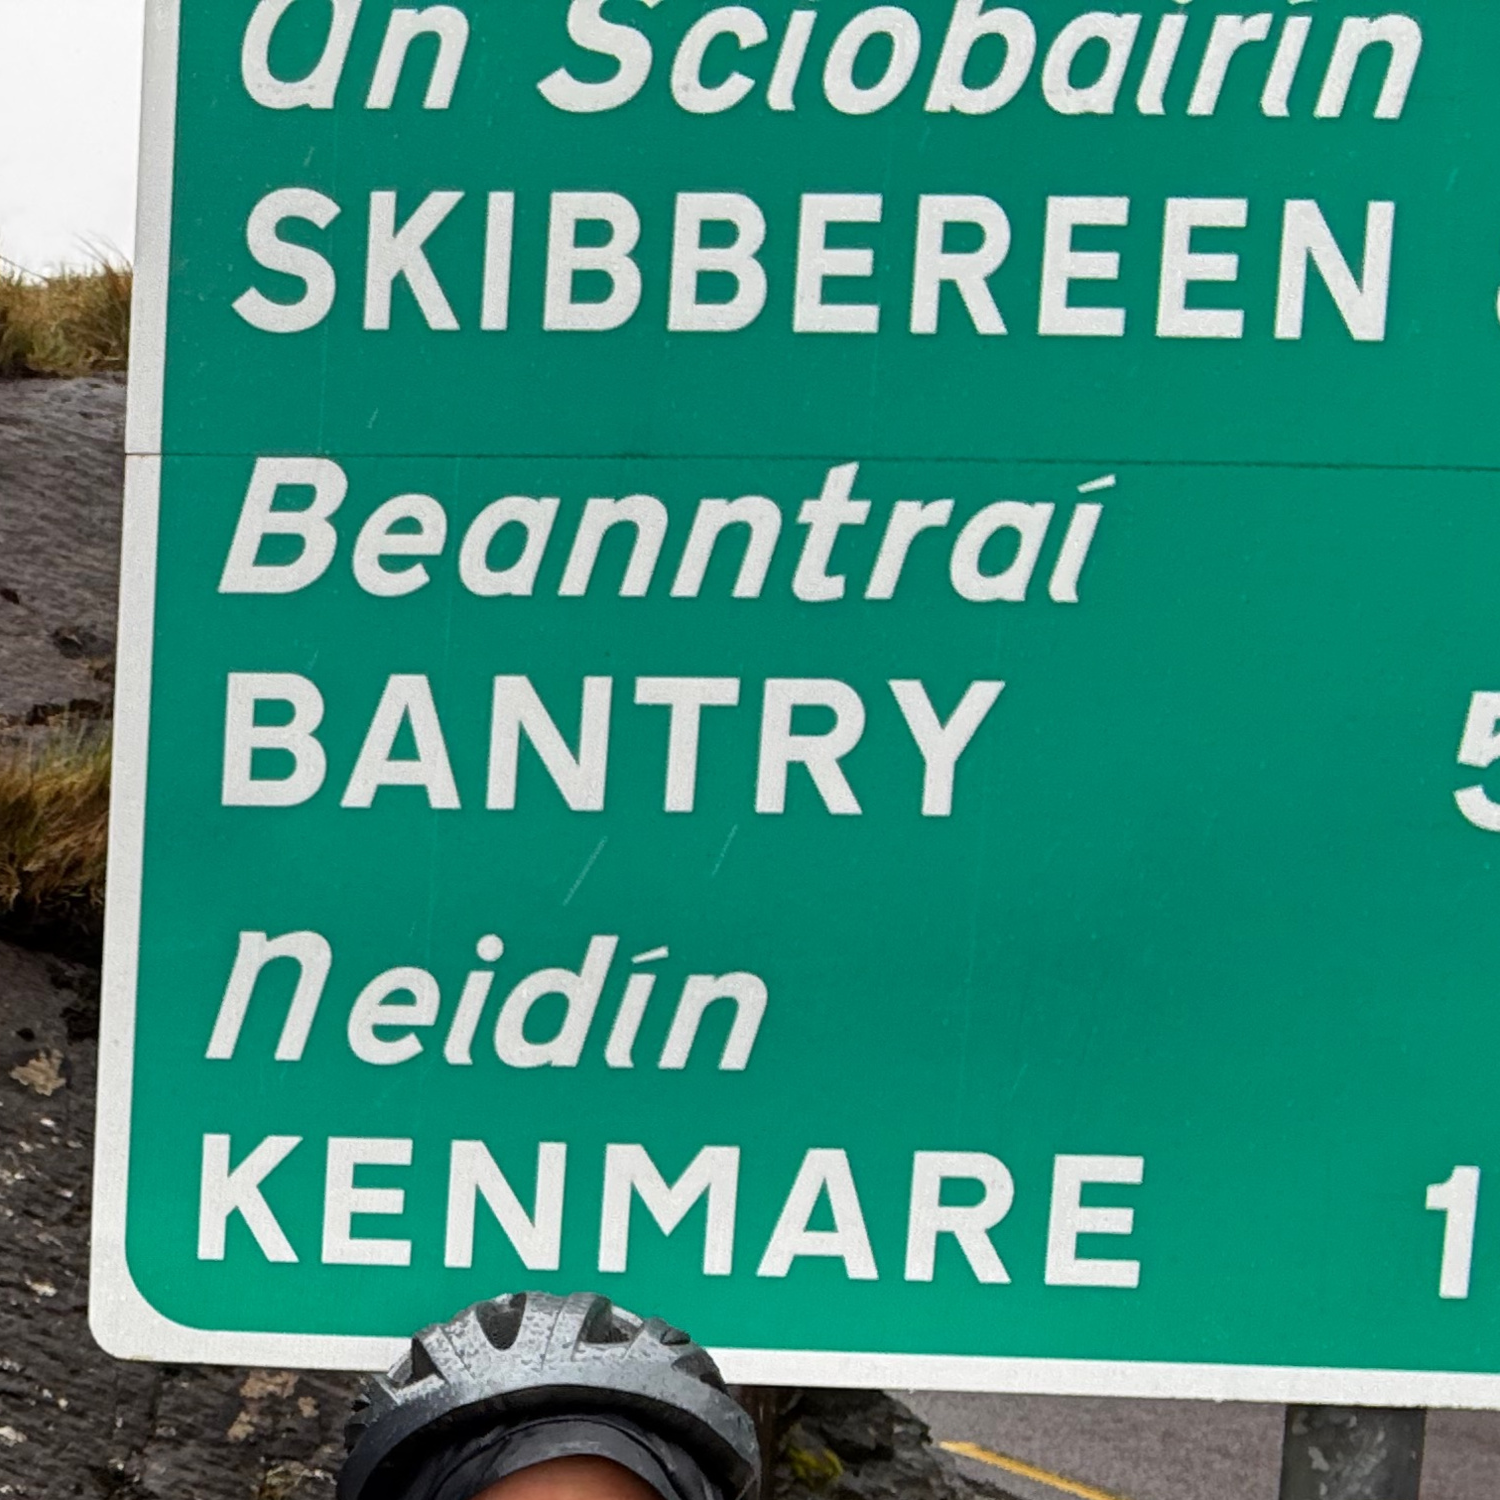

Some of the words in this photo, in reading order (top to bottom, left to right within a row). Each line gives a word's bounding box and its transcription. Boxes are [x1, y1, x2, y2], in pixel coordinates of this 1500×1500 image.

[232, 187, 1395, 341] SKIBBEREEN
[218, 457, 1116, 603] Beanntraí
[221, 672, 1005, 816] BANTRY
[197, 1133, 1144, 1288] KENMARE
